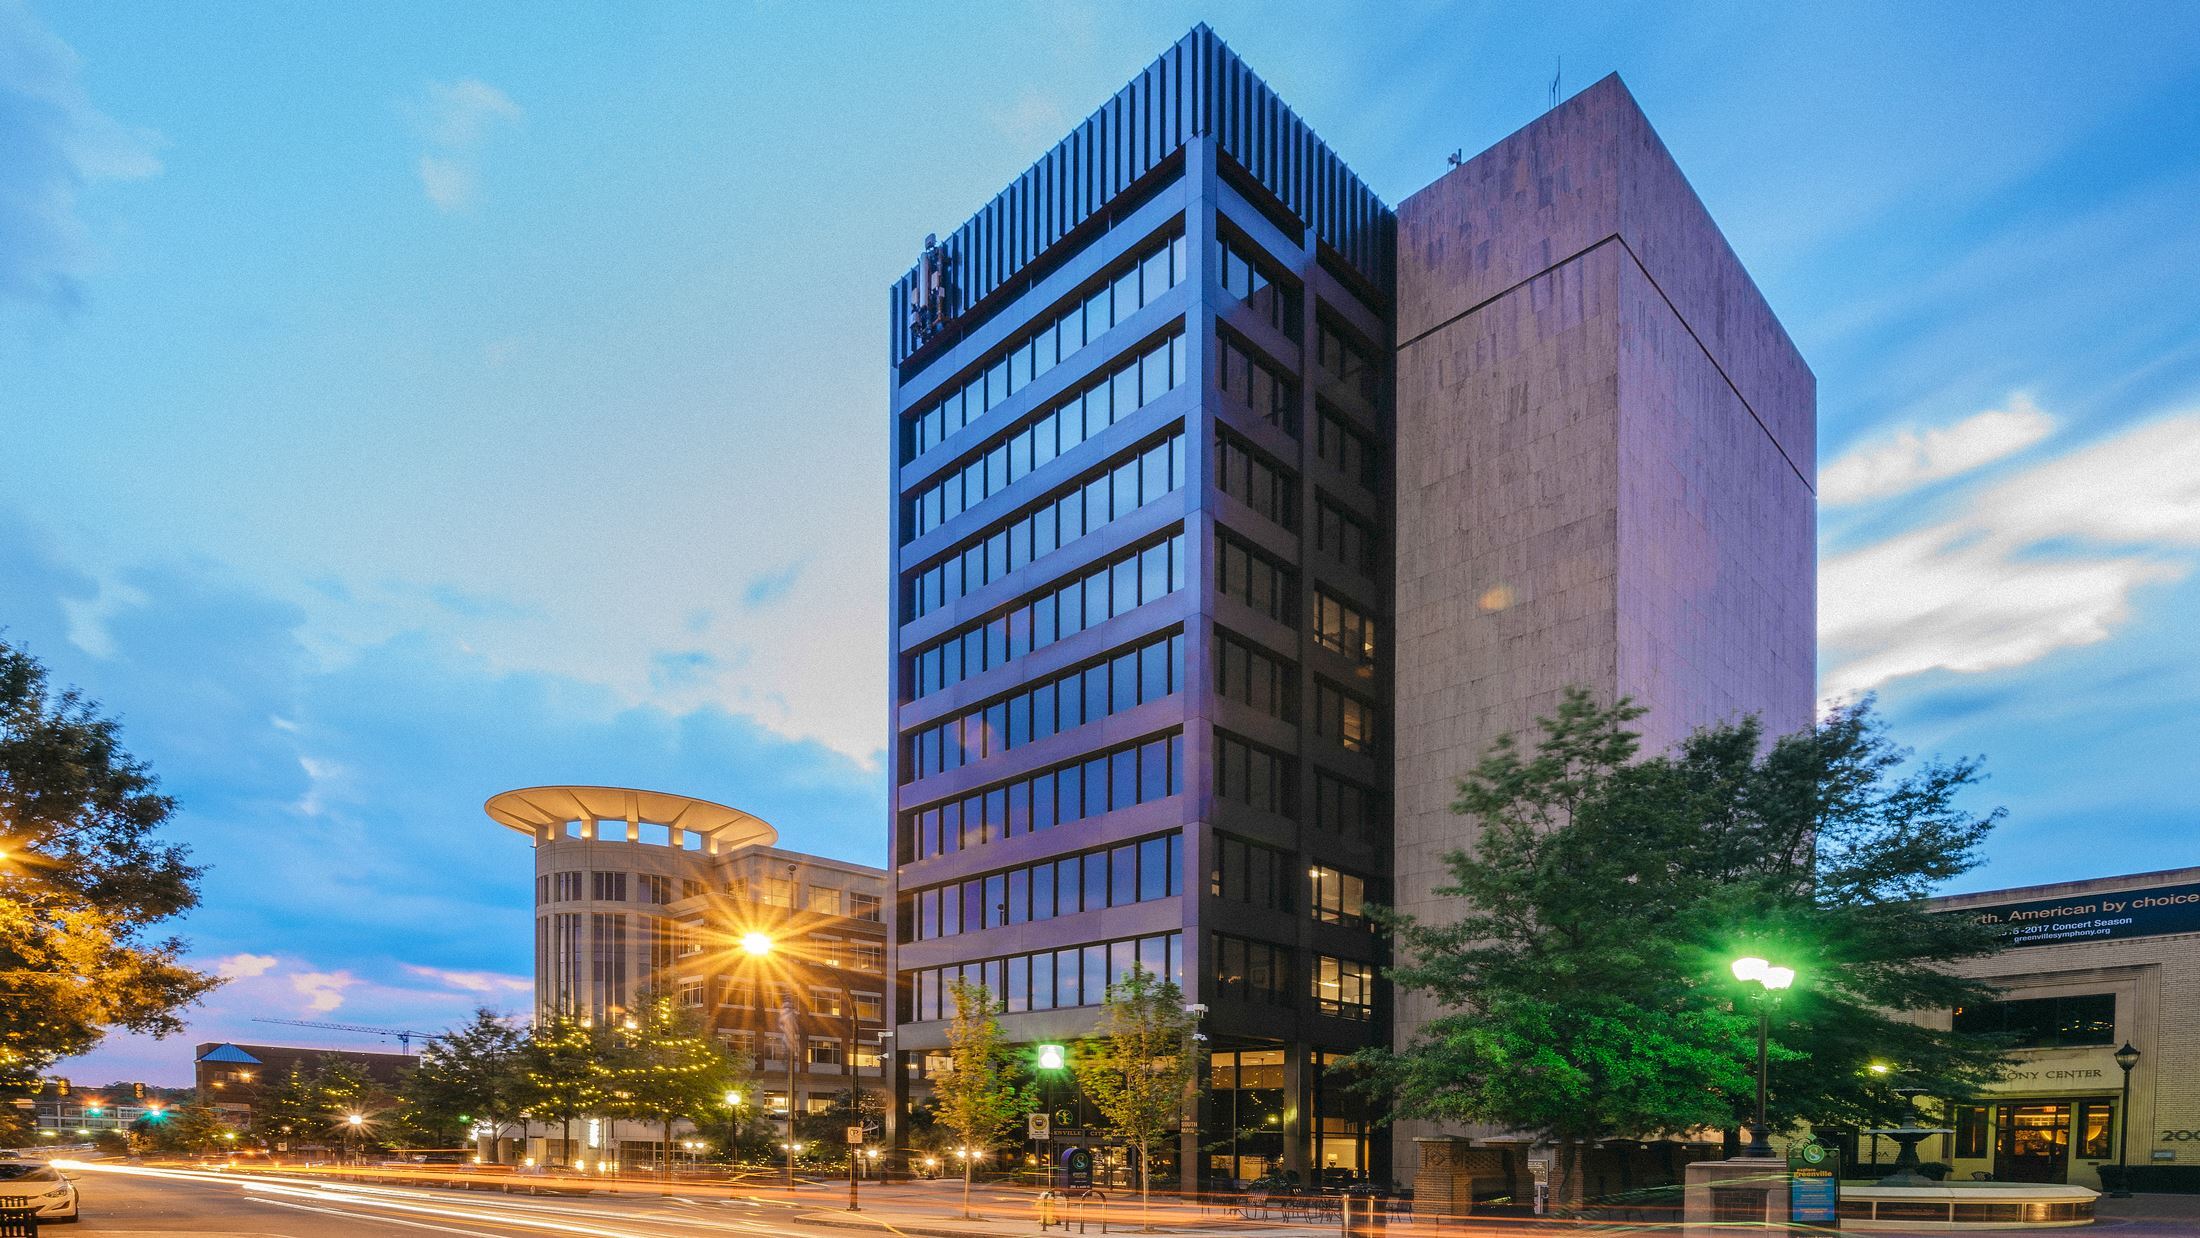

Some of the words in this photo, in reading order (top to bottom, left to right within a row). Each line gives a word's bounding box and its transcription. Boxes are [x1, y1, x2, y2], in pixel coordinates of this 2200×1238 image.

[2008, 904, 2096, 921] American
[2102, 901, 2127, 913] by
[2132, 893, 2200, 909] choice
[2052, 920, 2092, 931] Concert
[2094, 917, 2132, 928] Season
[2014, 928, 2111, 944] greenvillesymphony.org
[2045, 1069, 2102, 1079] CENTER
